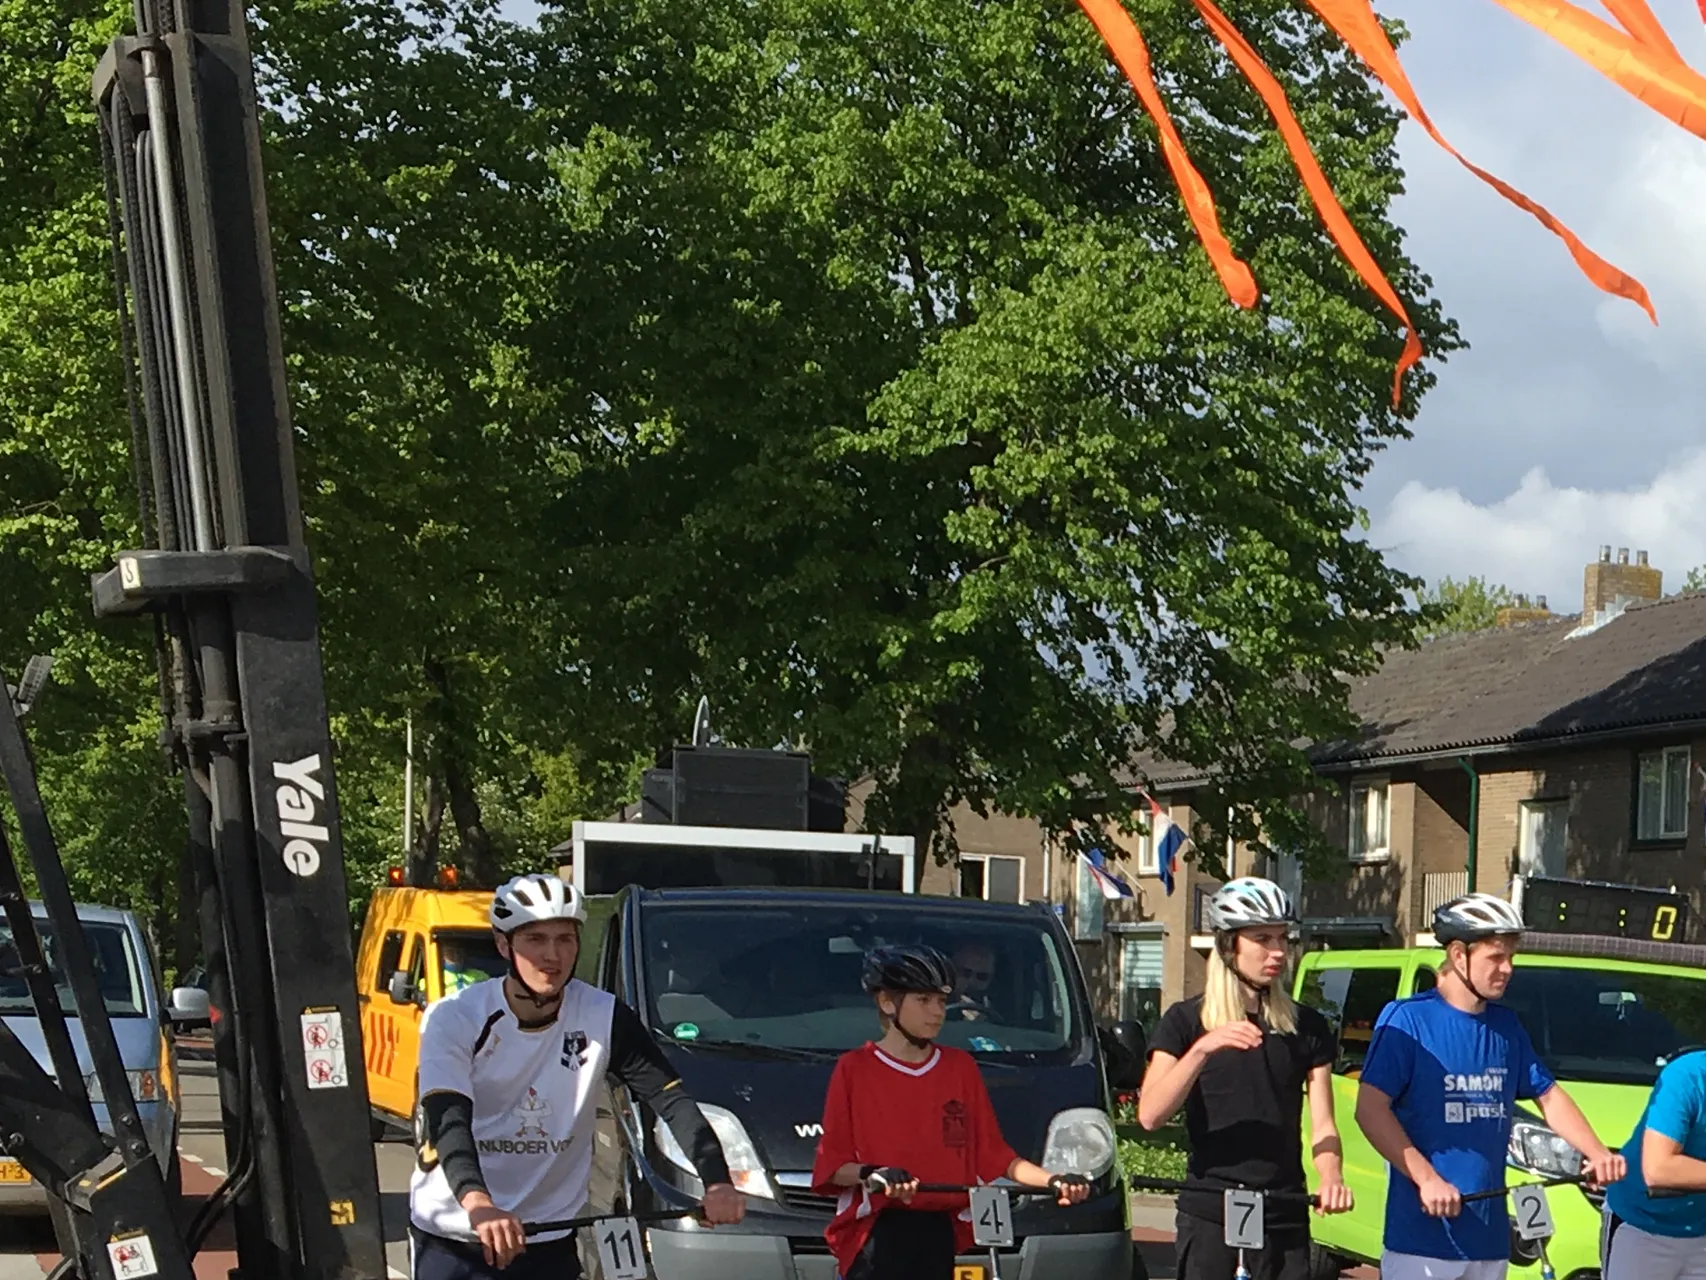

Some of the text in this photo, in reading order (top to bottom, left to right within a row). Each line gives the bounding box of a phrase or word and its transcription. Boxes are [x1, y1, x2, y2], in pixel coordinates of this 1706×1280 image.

[273, 753, 329, 876] Yale
[479, 1139, 547, 1154] NIJBOER
[979, 1199, 1003, 1234] 4
[1233, 1202, 1255, 1236] 7
[1522, 1196, 1546, 1228] 2
[604, 1229, 636, 1269] 11
